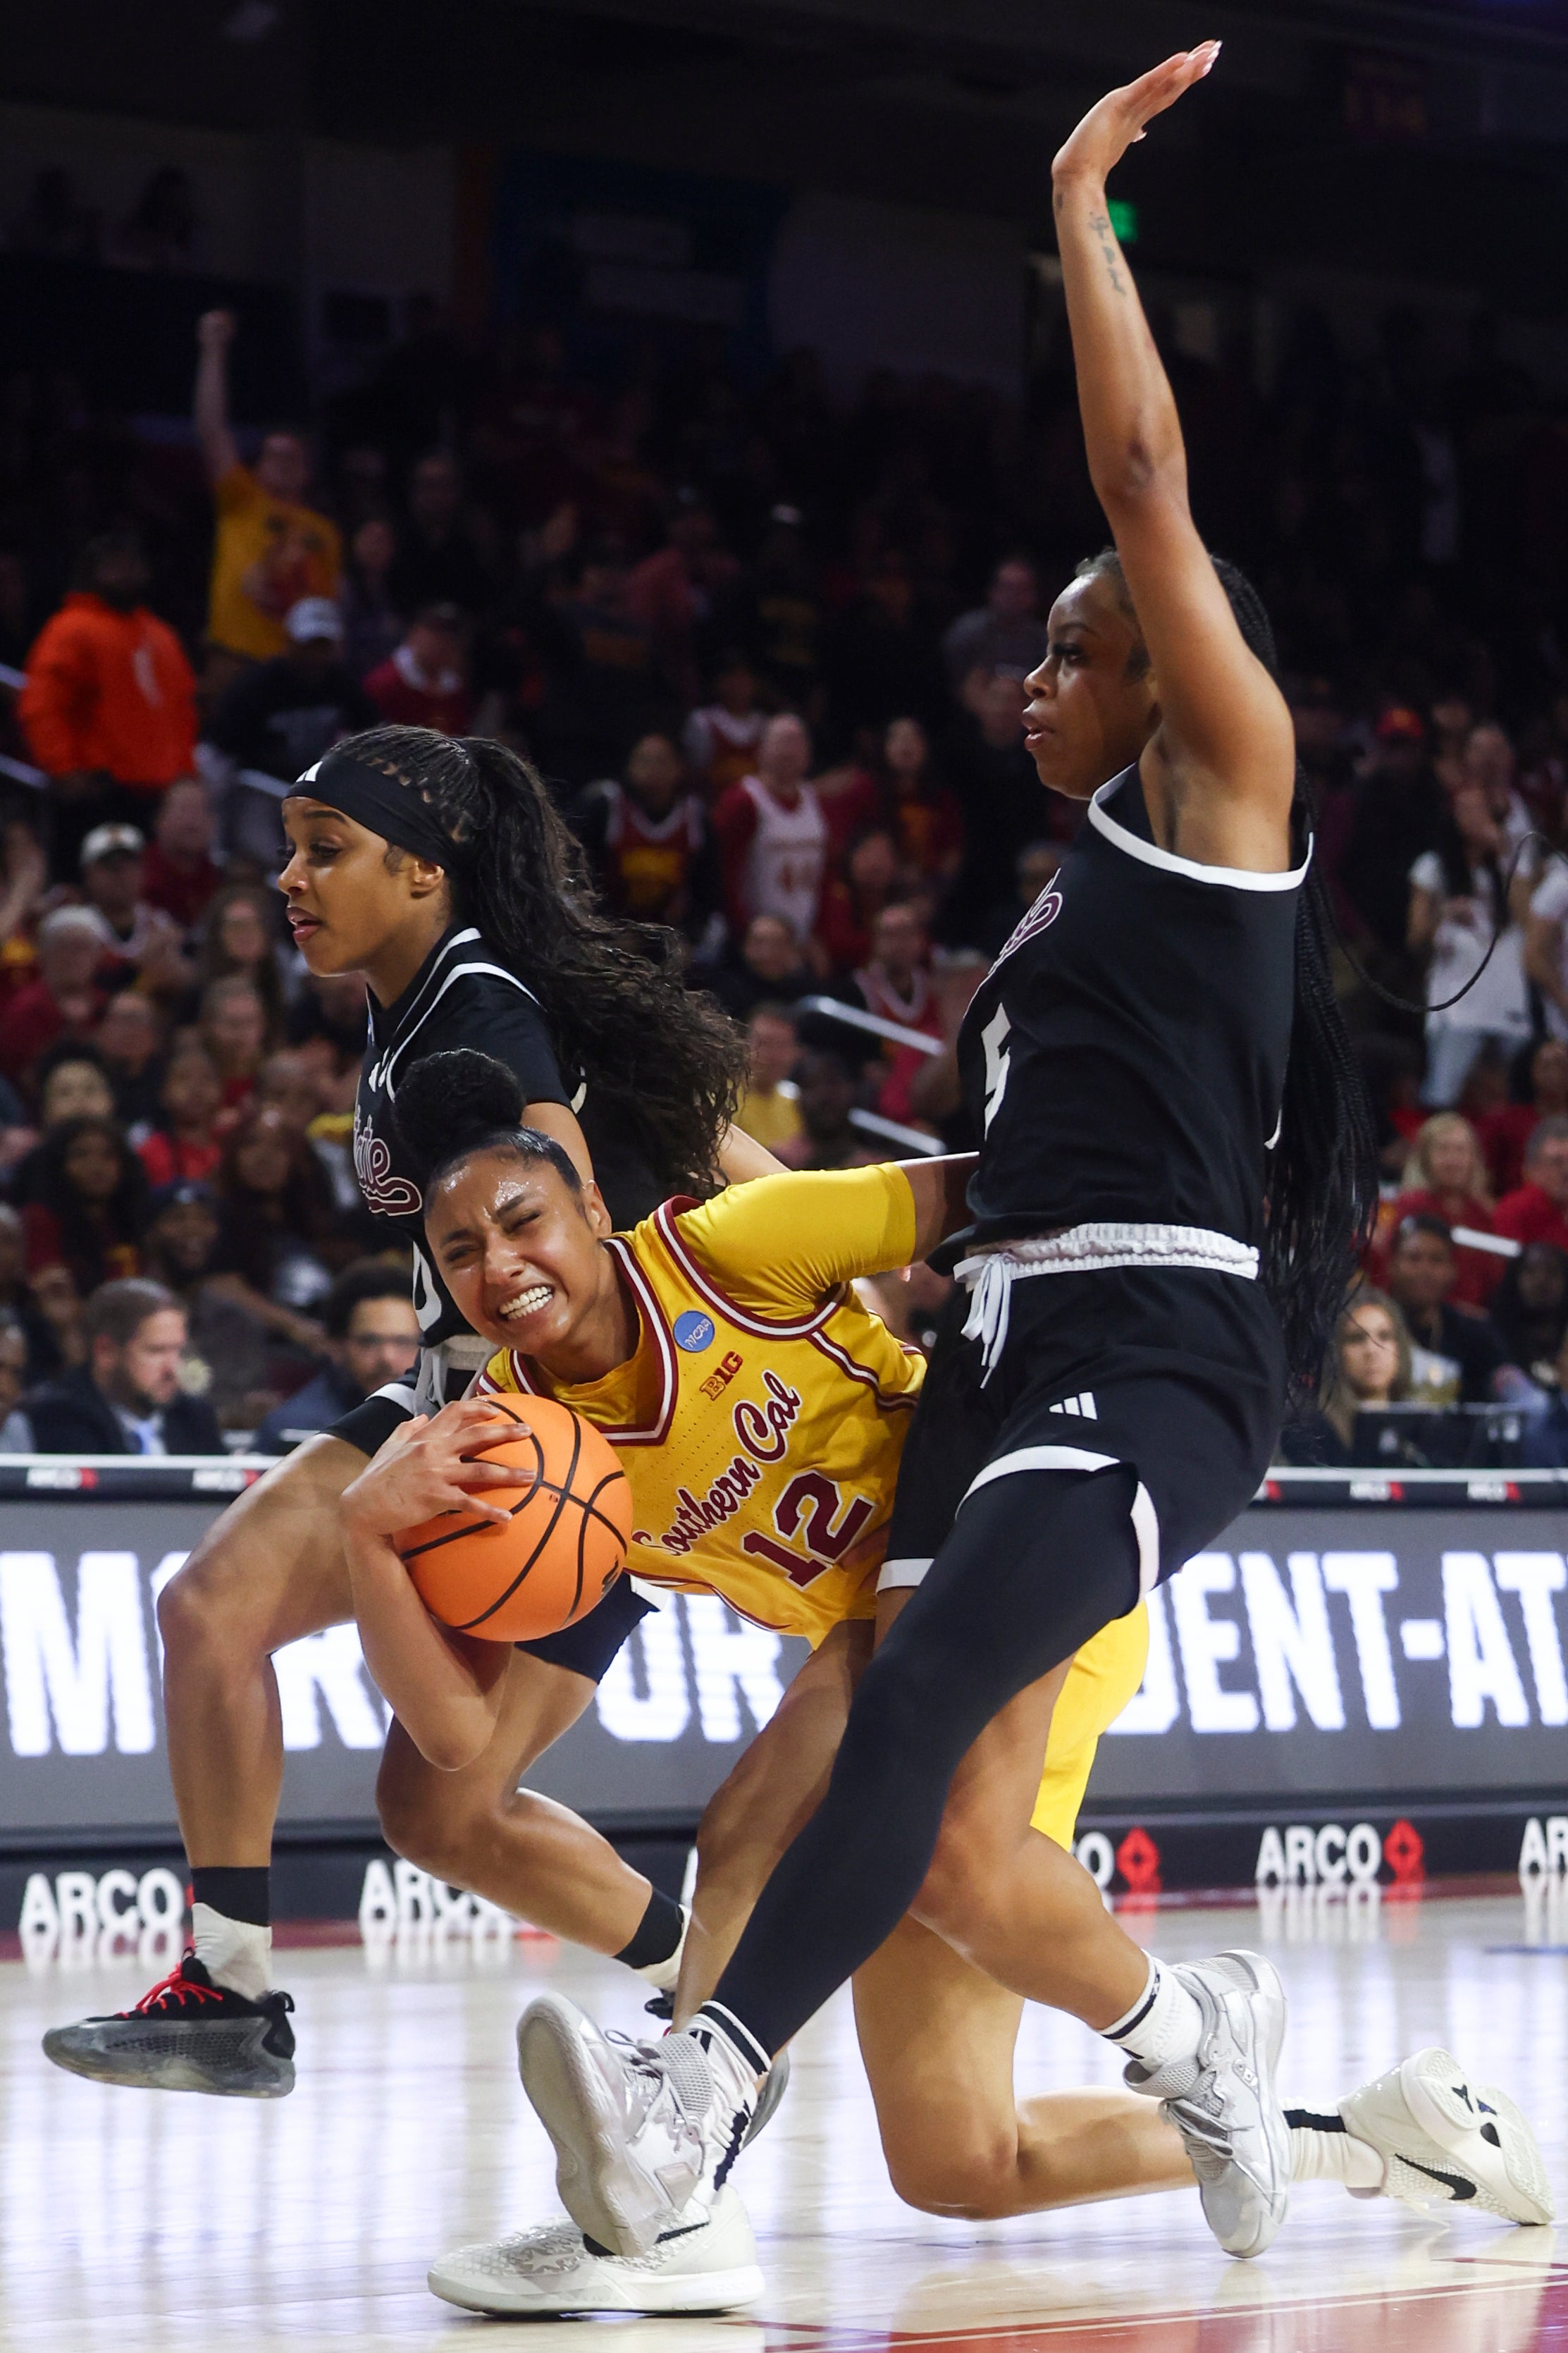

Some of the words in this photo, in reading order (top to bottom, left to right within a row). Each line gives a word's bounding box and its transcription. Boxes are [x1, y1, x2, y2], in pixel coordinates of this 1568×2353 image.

[684, 1318, 712, 1348] NCAA
[631, 1456, 763, 1556] Southern
[732, 1369, 802, 1463] Cal
[740, 1470, 879, 1592] 12
[1255, 1822, 1381, 1881] ARCO
[20, 1867, 185, 1928] ARCO
